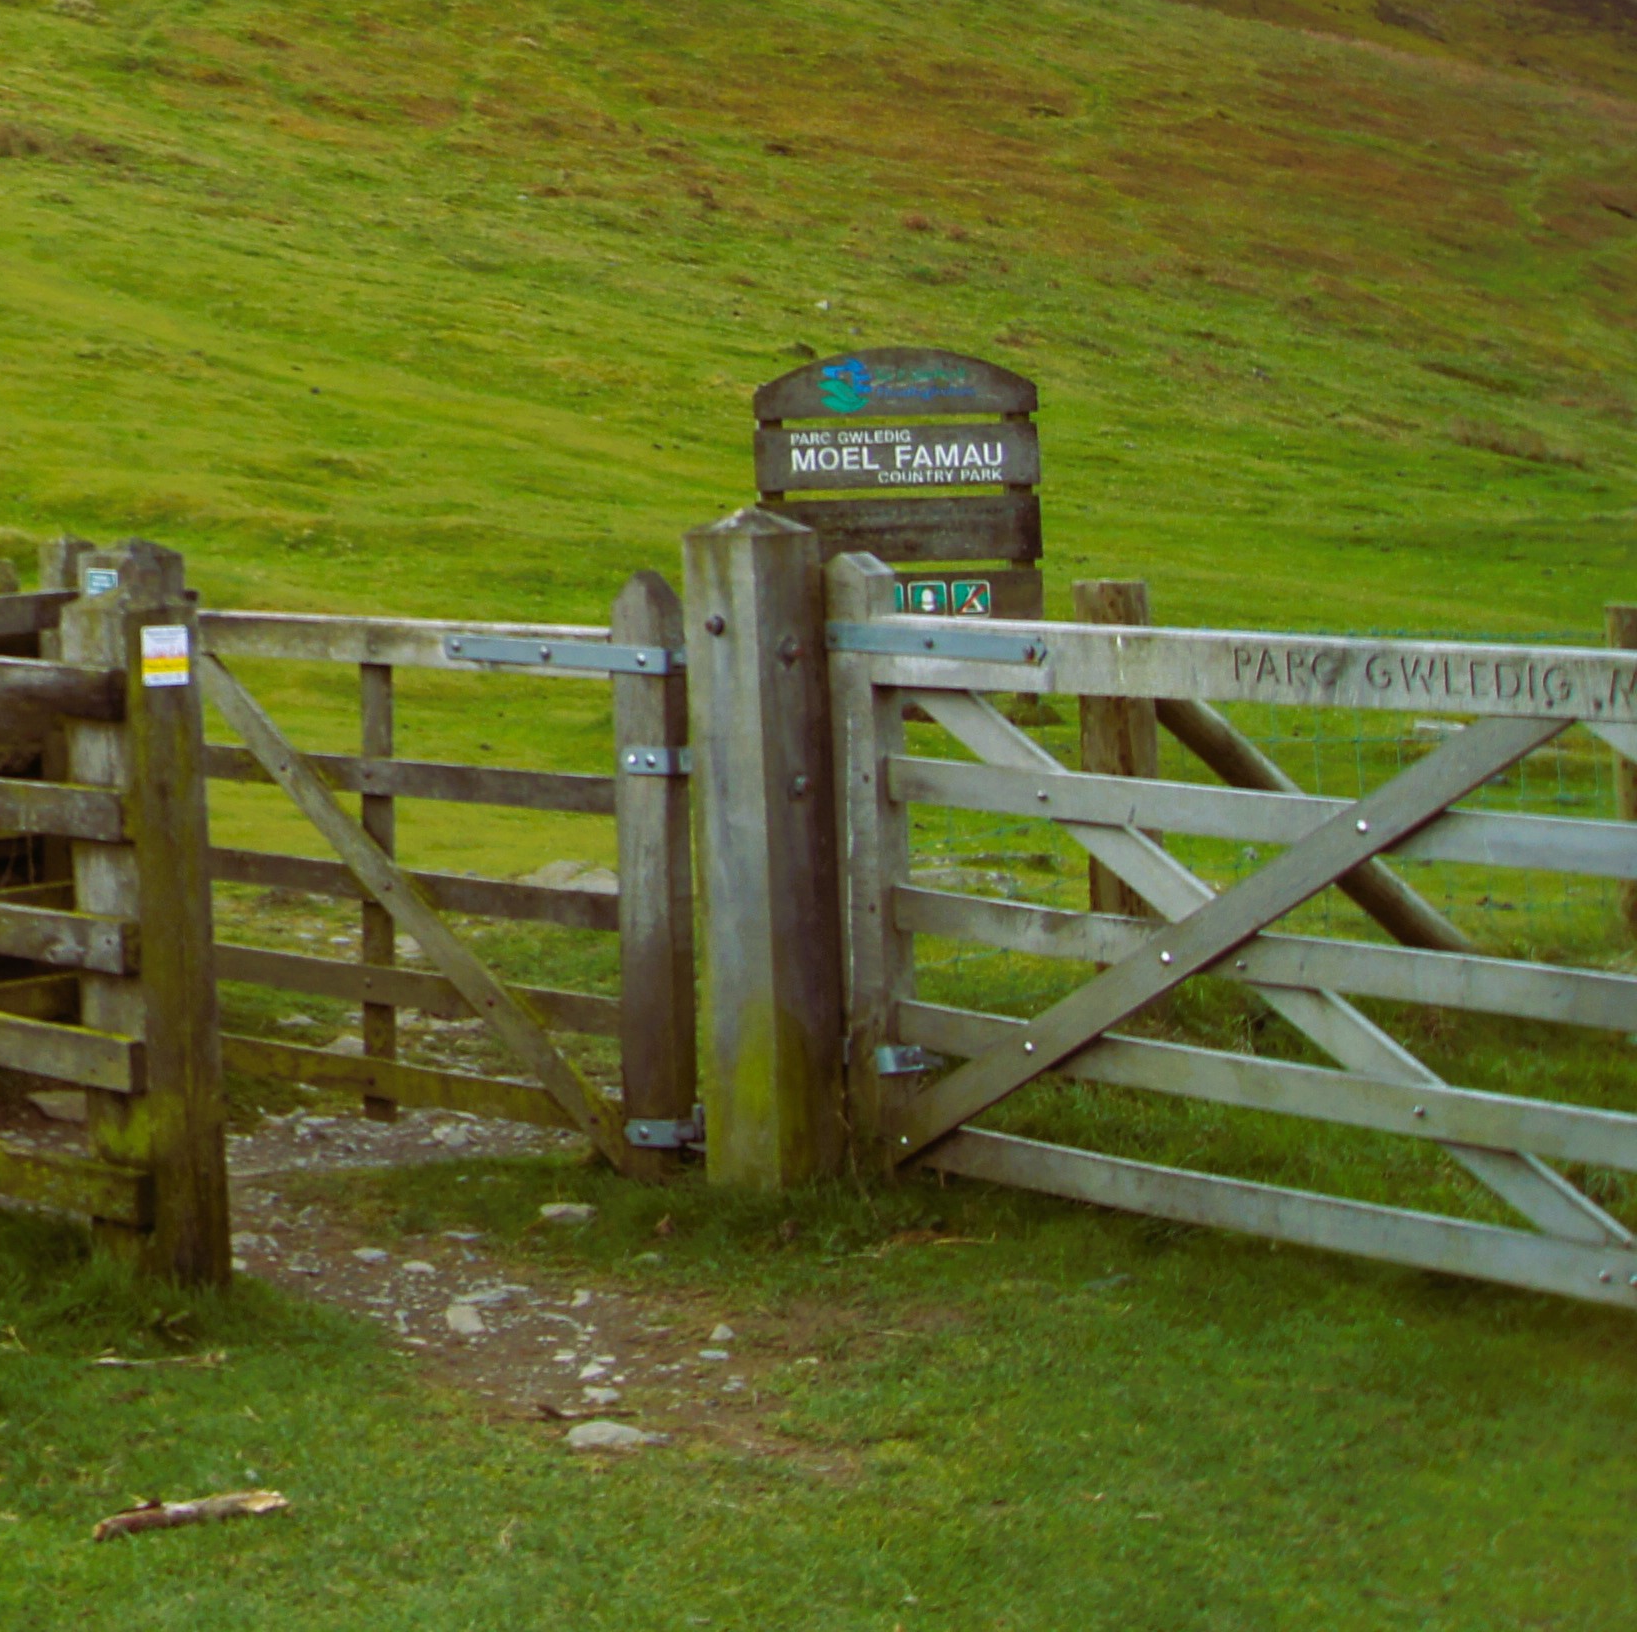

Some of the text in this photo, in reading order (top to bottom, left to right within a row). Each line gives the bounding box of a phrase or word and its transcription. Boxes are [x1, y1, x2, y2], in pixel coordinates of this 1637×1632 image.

[790, 429, 911, 446] PARC GWLEDIG
[791, 442, 1003, 473] MOEL FAMAU
[877, 467, 1003, 484] COUNTRY PARK
[1233, 646, 1342, 690] PARC
[1365, 653, 1574, 701] GWLEDIG
